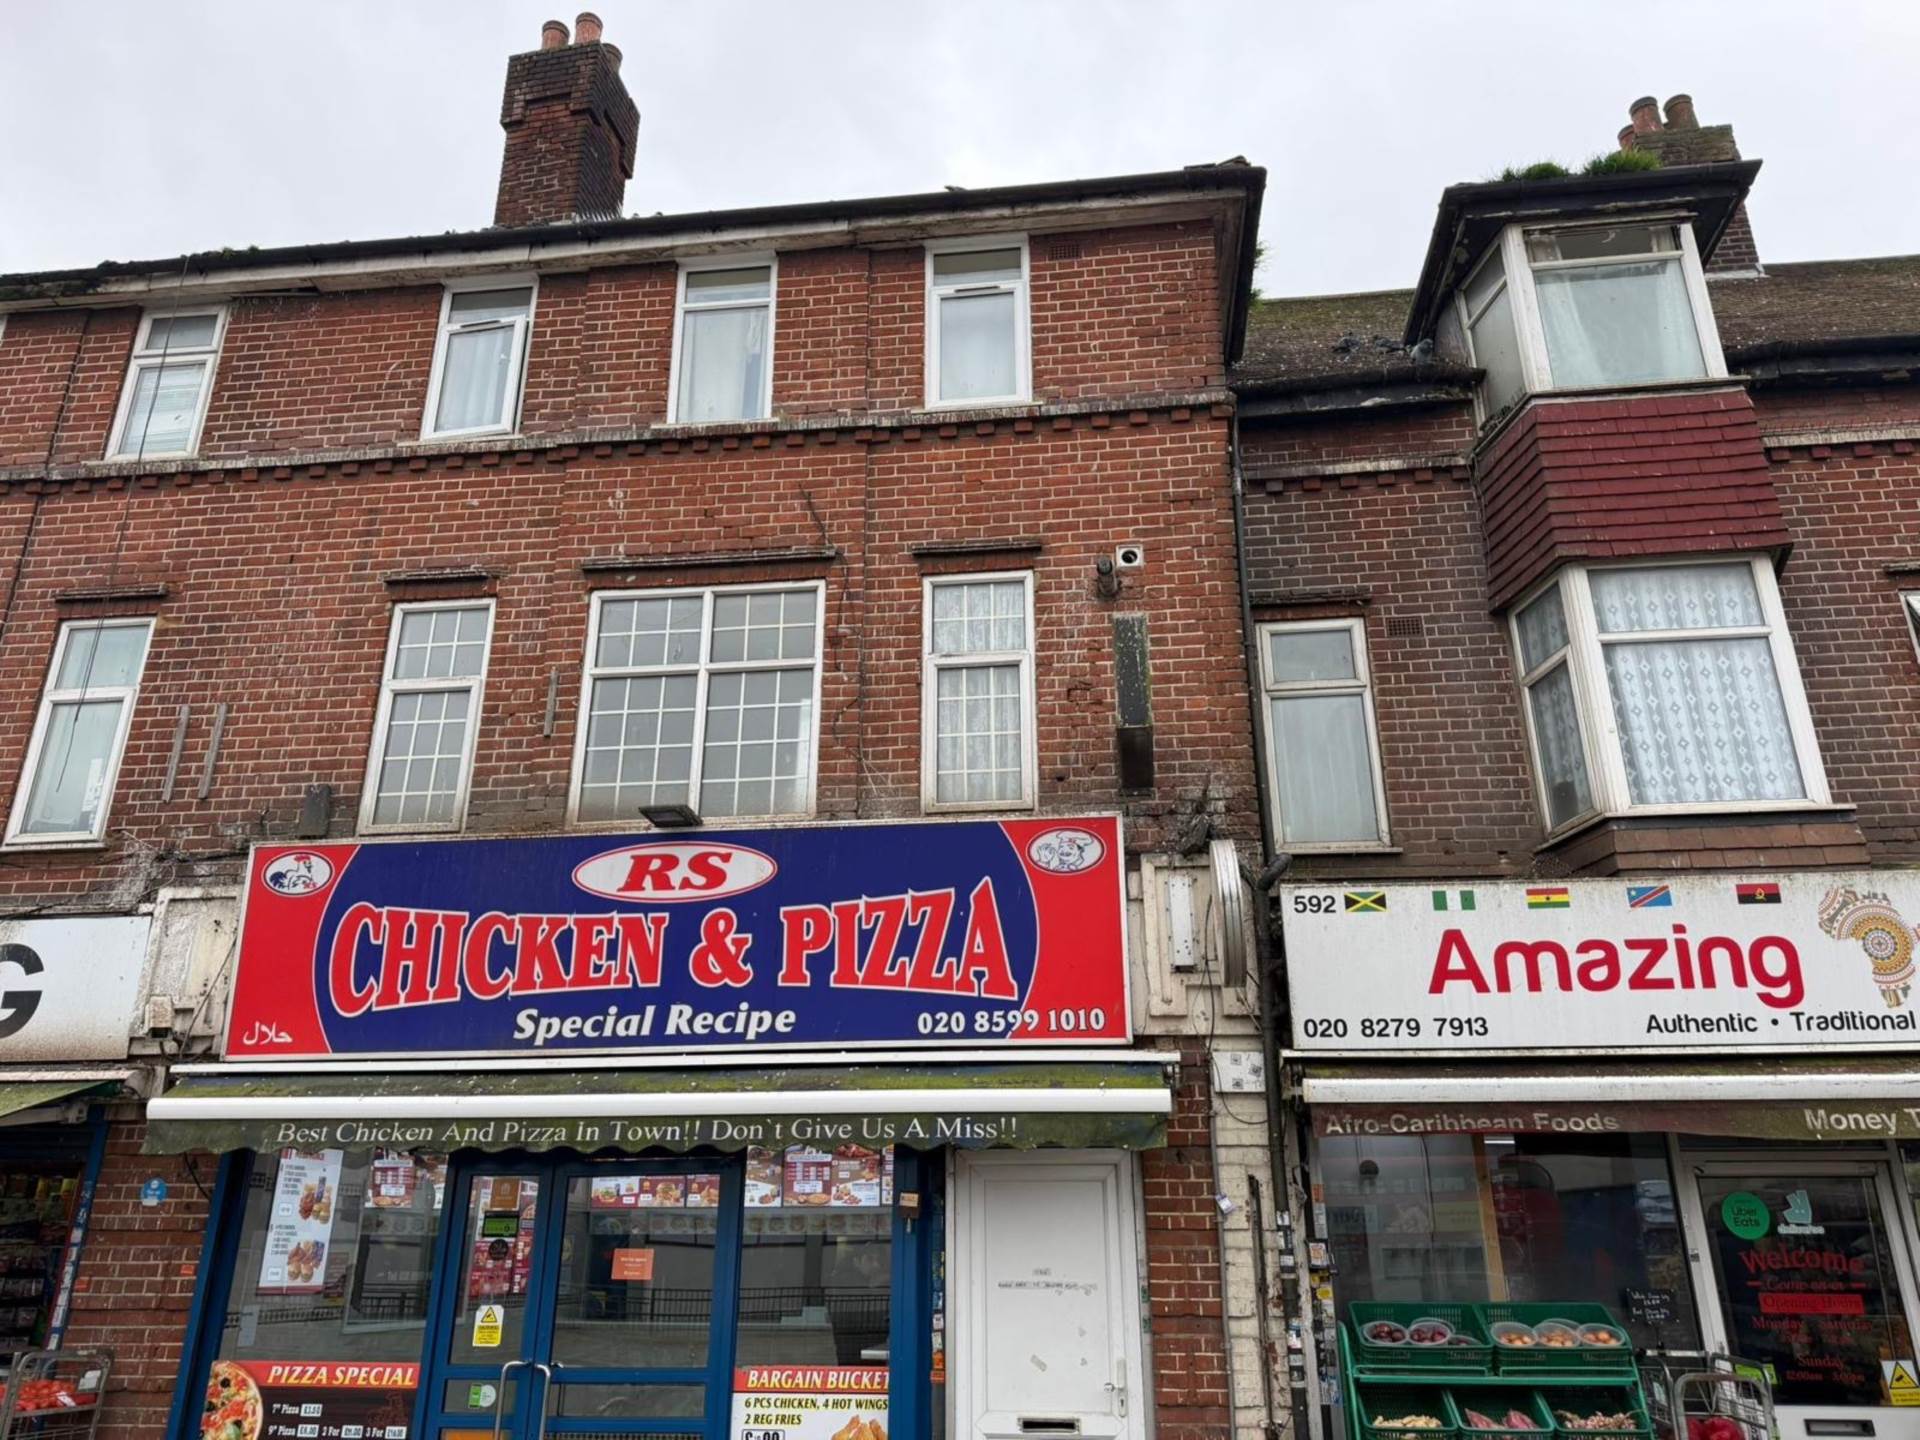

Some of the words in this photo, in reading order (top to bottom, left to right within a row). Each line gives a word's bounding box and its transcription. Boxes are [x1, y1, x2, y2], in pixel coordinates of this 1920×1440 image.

[617, 851, 733, 892] RS
[1293, 895, 1336, 913] 592
[329, 902, 669, 1017] CHICKEN
[689, 908, 753, 987] &
[778, 876, 1018, 1000] PIZZA
[1428, 923, 1805, 1008] Amazing
[513, 1004, 656, 1046] Special
[664, 1001, 796, 1040] Recipe
[917, 1011, 966, 1034] 020
[973, 1009, 1040, 1033] 8599
[1047, 1008, 1105, 1031] 1010
[1303, 1018, 1348, 1038] 020
[1360, 1018, 1421, 1038] 8279
[1433, 1017, 1489, 1037] 7913
[1646, 1013, 1759, 1034] Authentic
[1789, 1010, 1917, 1032] Traditional
[242, 1021, 293, 1046] حلال
[276, 1121, 329, 1142] Best
[335, 1121, 434, 1142] Chicken
[442, 1122, 495, 1142] And
[503, 1121, 567, 1143] Pizza
[576, 1121, 599, 1140] In
[610, 1119, 700, 1141] Town!!
[791, 1118, 853, 1138] Give
[862, 1118, 895, 1138] Us
[937, 1117, 1018, 1139] Miss!!
[1325, 1113, 1524, 1134] Afro-Caribbean
[1533, 1112, 1620, 1133] Foods
[1804, 1108, 1897, 1136] Money
[1739, 1241, 1867, 1276] Welcome
[1796, 1353, 1845, 1370] Sunday
[267, 1366, 327, 1385] PIZZA
[333, 1366, 414, 1386] SPECIAL
[747, 1370, 822, 1388] BARGAIN
[827, 1371, 888, 1390] BUCKET
[744, 1398, 751, 1408] 6
[753, 1397, 771, 1408] PCS
[822, 1399, 829, 1409] 4
[832, 1398, 851, 1409] HOT
[744, 1415, 751, 1425] 2
[753, 1414, 772, 1425] REG
[775, 1414, 802, 1426] FRIES
